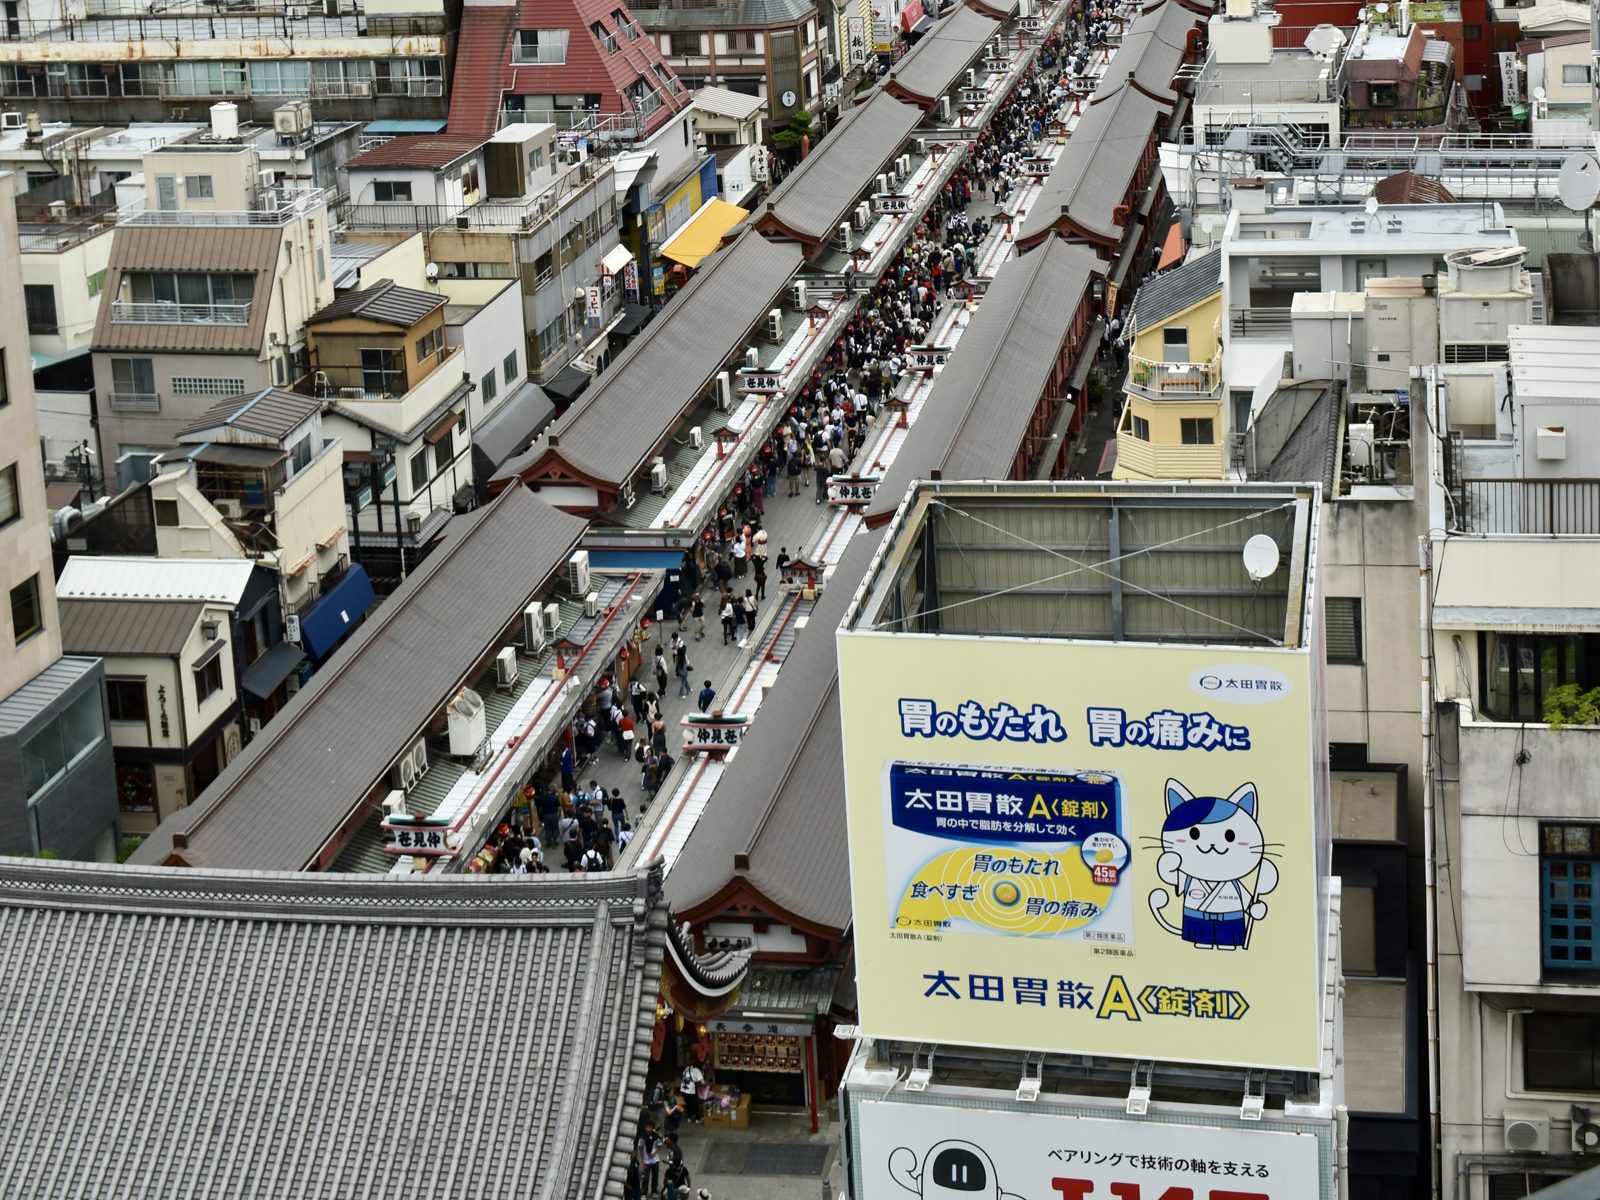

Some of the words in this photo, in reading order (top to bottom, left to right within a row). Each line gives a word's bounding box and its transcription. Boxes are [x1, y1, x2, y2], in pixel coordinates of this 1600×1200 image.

[590, 289, 599, 314] コーヒー
[1225, 678, 1283, 691] 太田胃散
[898, 698, 1067, 744] 胃のもたれ
[1087, 706, 1251, 752] 胃の痛みに
[935, 816, 1077, 836] 胃の中で脂肪を分解して効く
[973, 854, 1060, 876] 胃のもたれ
[1094, 866, 1117, 878] 45錠
[910, 880, 980, 901] 食べすぎ
[1025, 897, 1099, 918] 胃の痛み
[913, 919, 952, 928] 太田胃散
[1093, 947, 1134, 958] 第2類医薬品
[1048, 1149, 1270, 1178] ベアリングで技術の軸を支える
